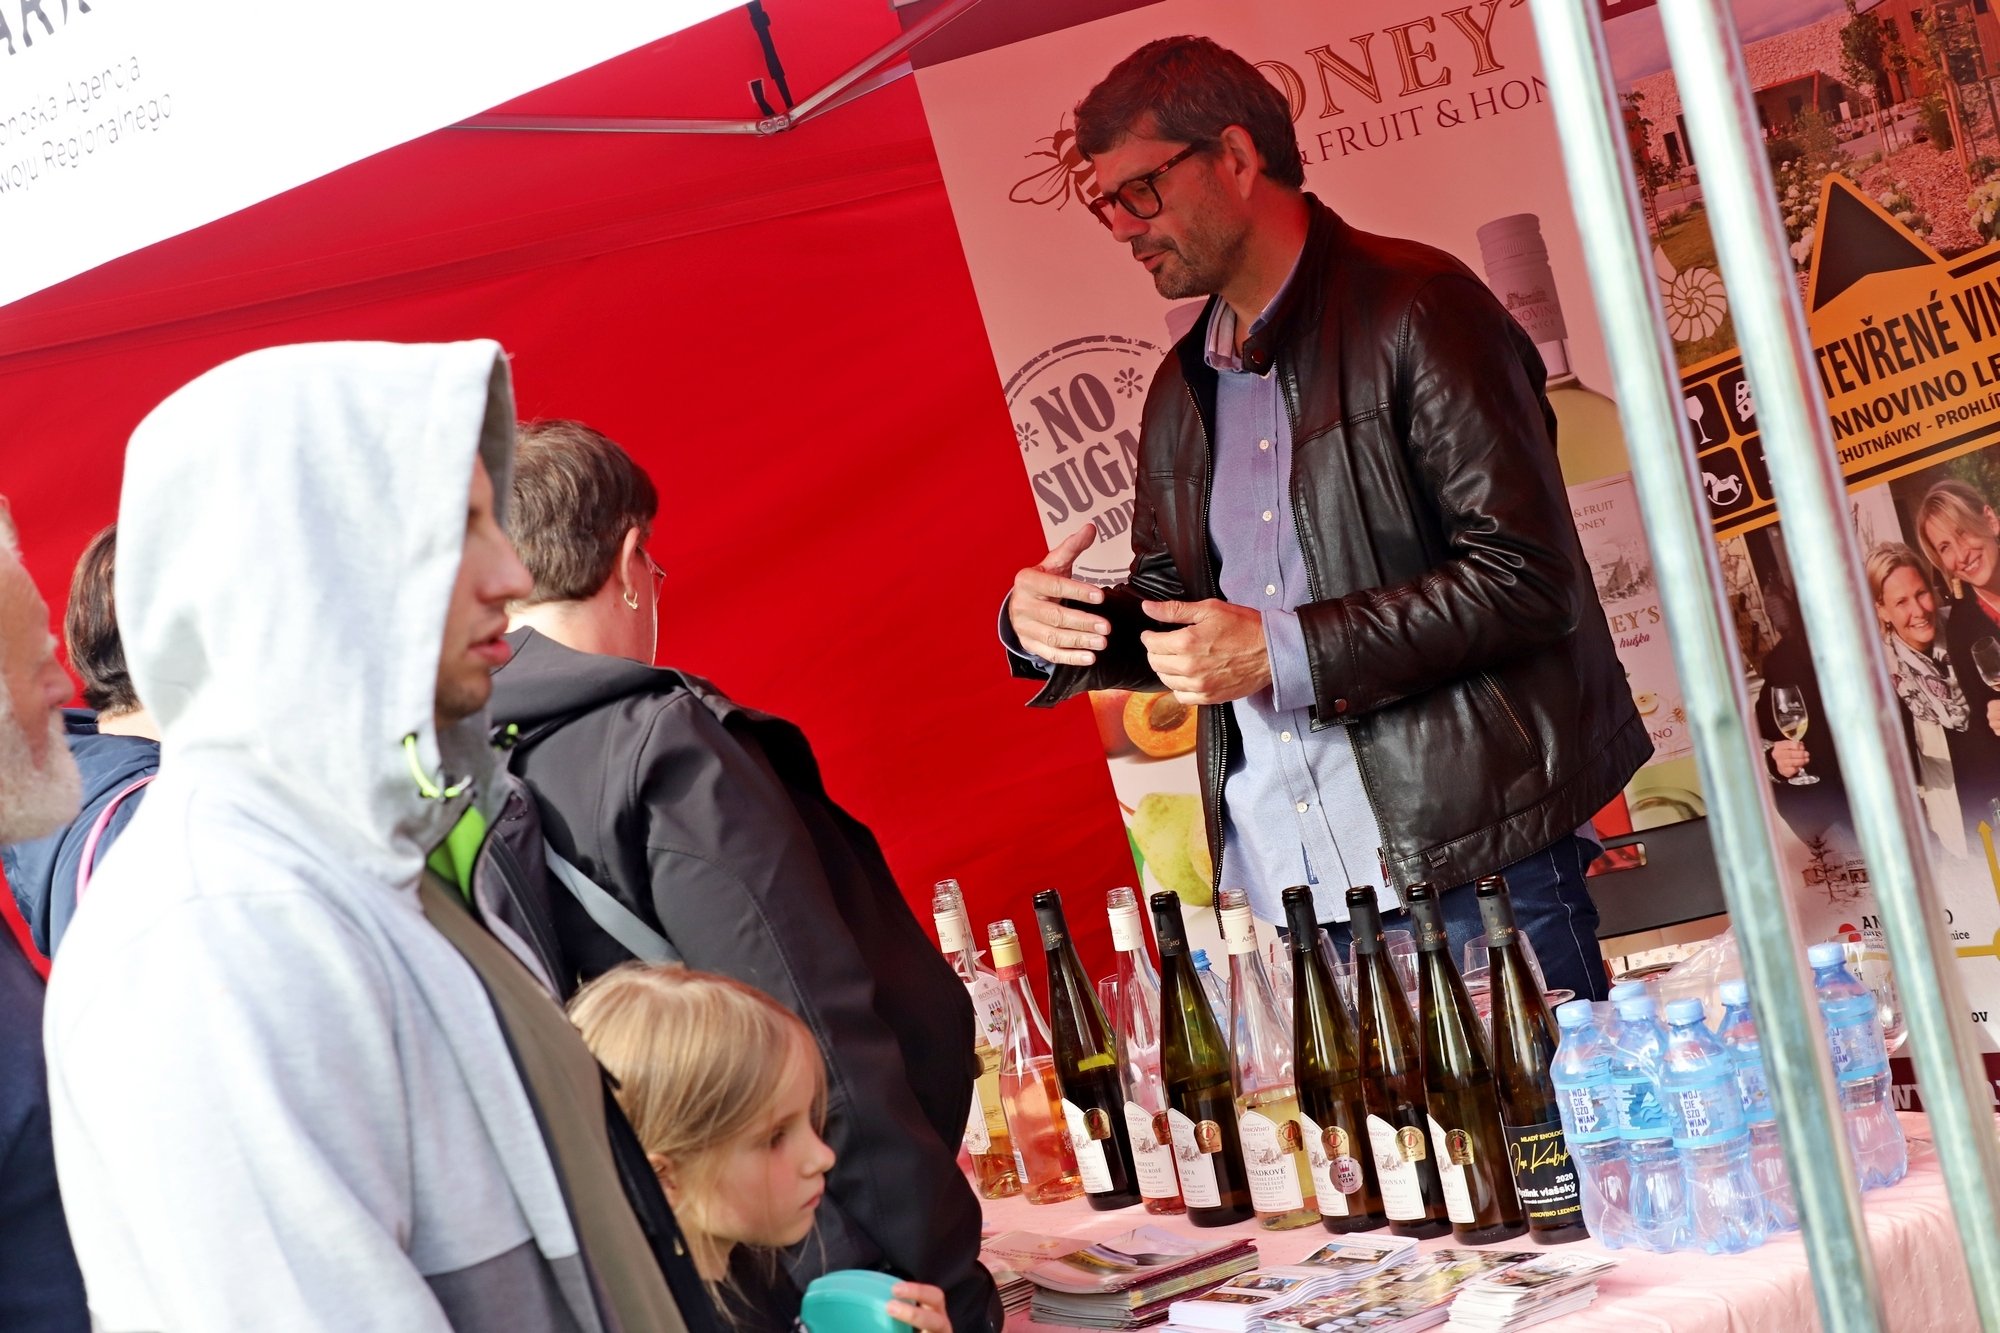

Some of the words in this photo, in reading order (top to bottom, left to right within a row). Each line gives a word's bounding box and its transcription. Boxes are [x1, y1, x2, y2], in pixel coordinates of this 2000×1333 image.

[66, 56, 141, 113] Agencja
[41, 93, 172, 173] Regionalnego
[1315, 106, 1424, 162] FRUIT
[1436, 99, 1466, 128] &
[1030, 373, 1115, 454] NO
[1830, 369, 1967, 442] NNOVINO
[1032, 424, 1142, 526] SUGA
[1583, 500, 1614, 516] FRUIT
[1555, 1172, 1574, 1184] 2020
